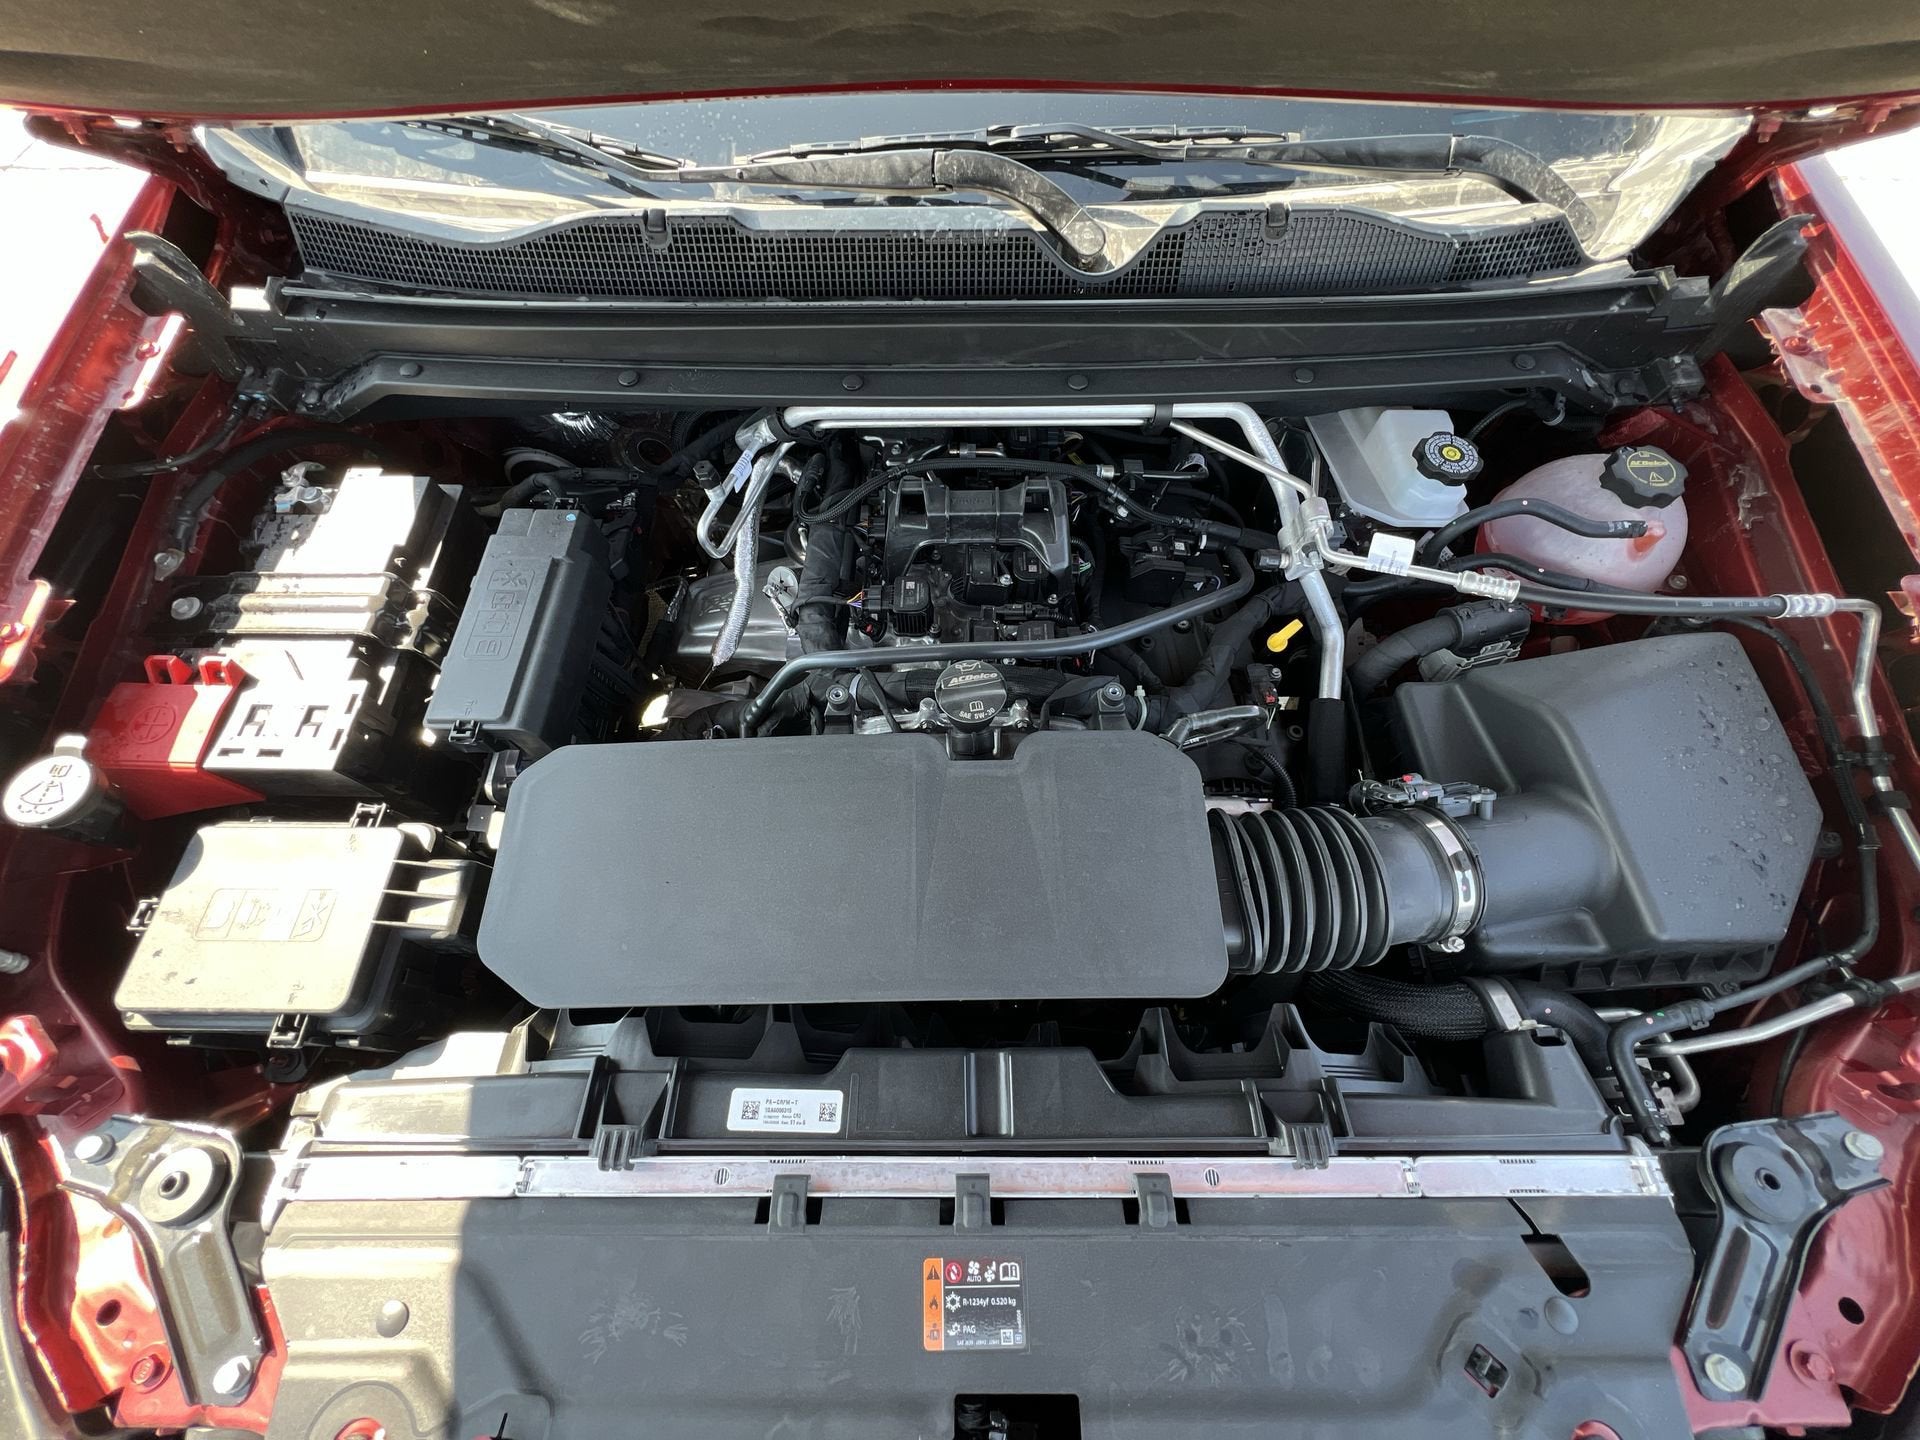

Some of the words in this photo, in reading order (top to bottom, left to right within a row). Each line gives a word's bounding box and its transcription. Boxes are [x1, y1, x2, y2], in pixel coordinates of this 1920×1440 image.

[948, 673, 998, 687] ACDelco
[959, 711, 972, 720] SAE
[966, 1275, 982, 1283] AUTO
[962, 1297, 989, 1308] R-1234yf
[990, 1297, 1008, 1306] 0.520
[1008, 1296, 1017, 1307] kg
[962, 1325, 976, 1334] PAG
